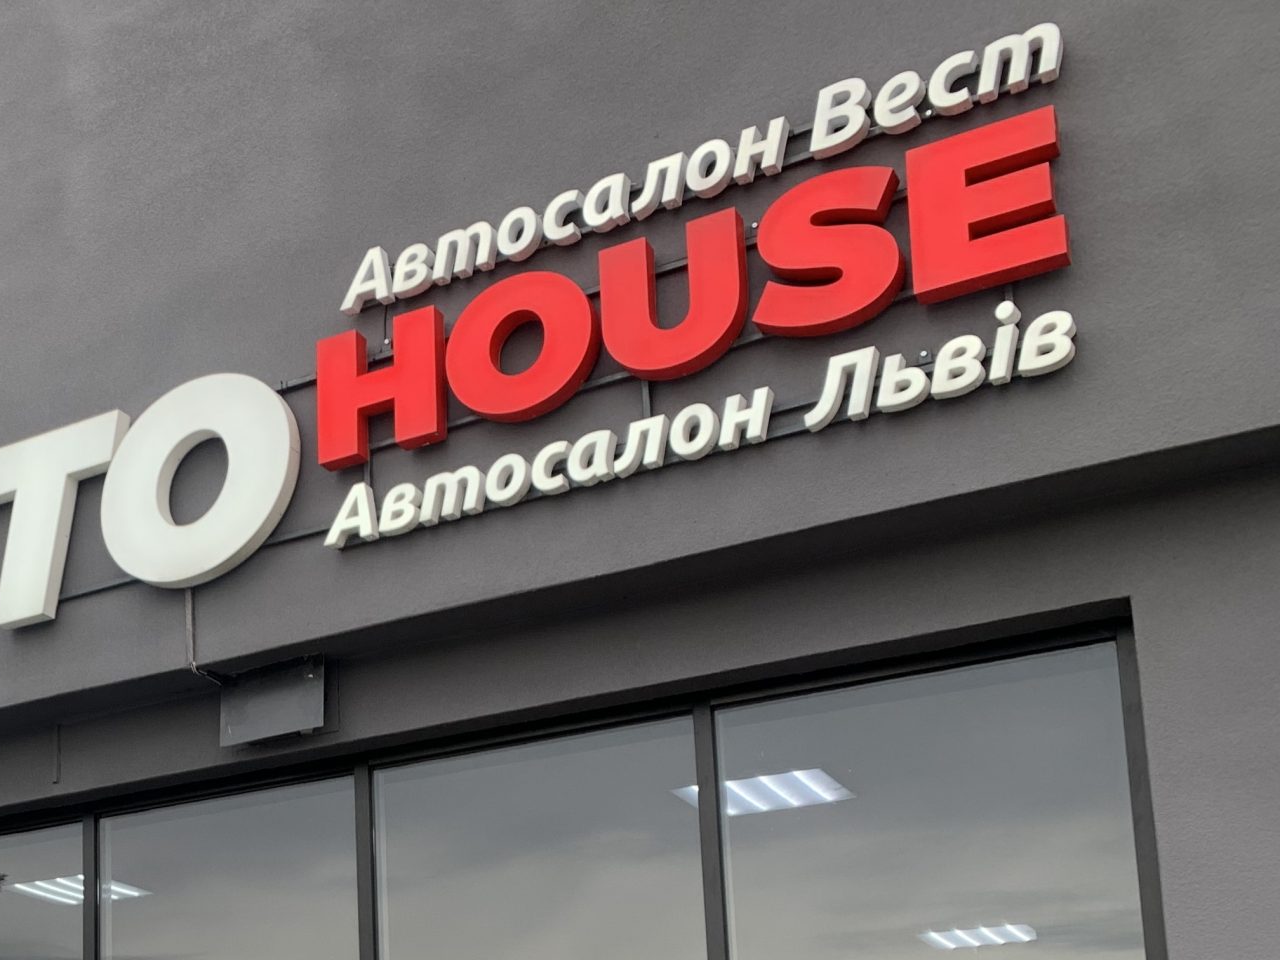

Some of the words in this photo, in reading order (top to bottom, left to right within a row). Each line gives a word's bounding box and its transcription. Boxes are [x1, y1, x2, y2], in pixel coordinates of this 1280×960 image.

[316, 105, 1072, 471] HOUSE
[339, 115, 790, 316] Автосалон
[808, 22, 1063, 160] Вест
[323, 386, 774, 550] Автосалон
[804, 300, 1077, 433] Львів
